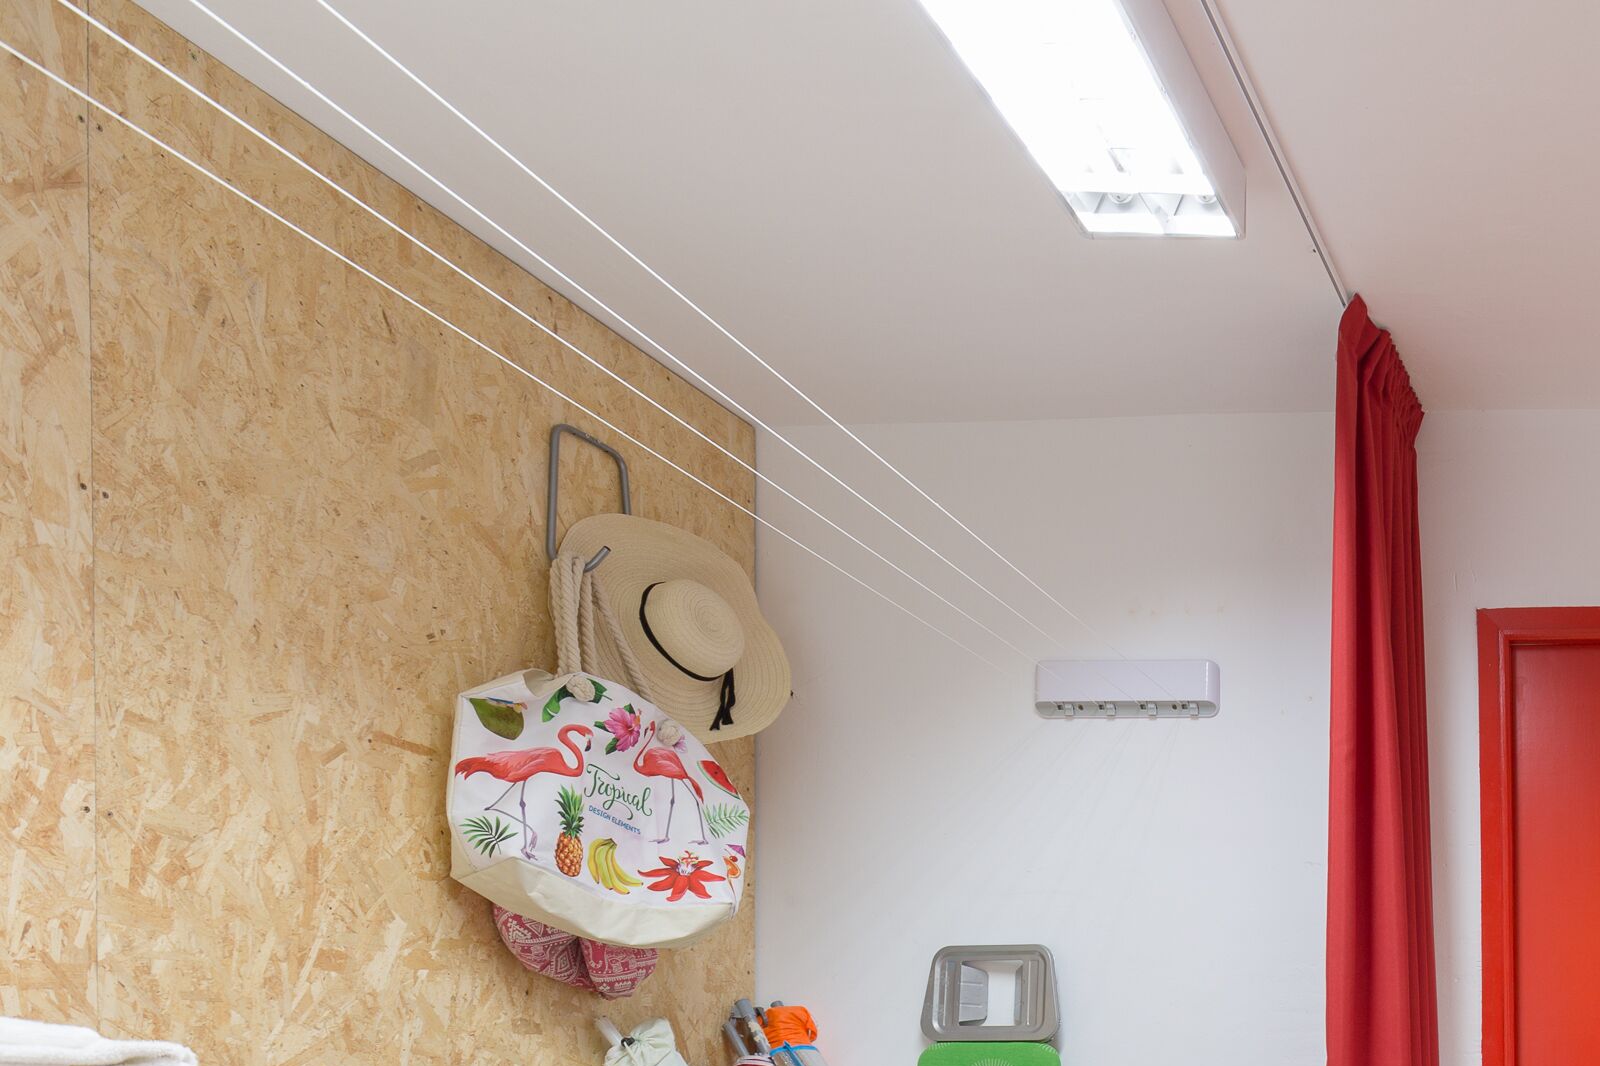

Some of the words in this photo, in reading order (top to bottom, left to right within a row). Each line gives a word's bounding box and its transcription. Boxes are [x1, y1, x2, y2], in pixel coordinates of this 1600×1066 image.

[584, 764, 652, 820] Tropical
[588, 805, 611, 821] DESIGN
[611, 816, 641, 834] ELEMENTS
